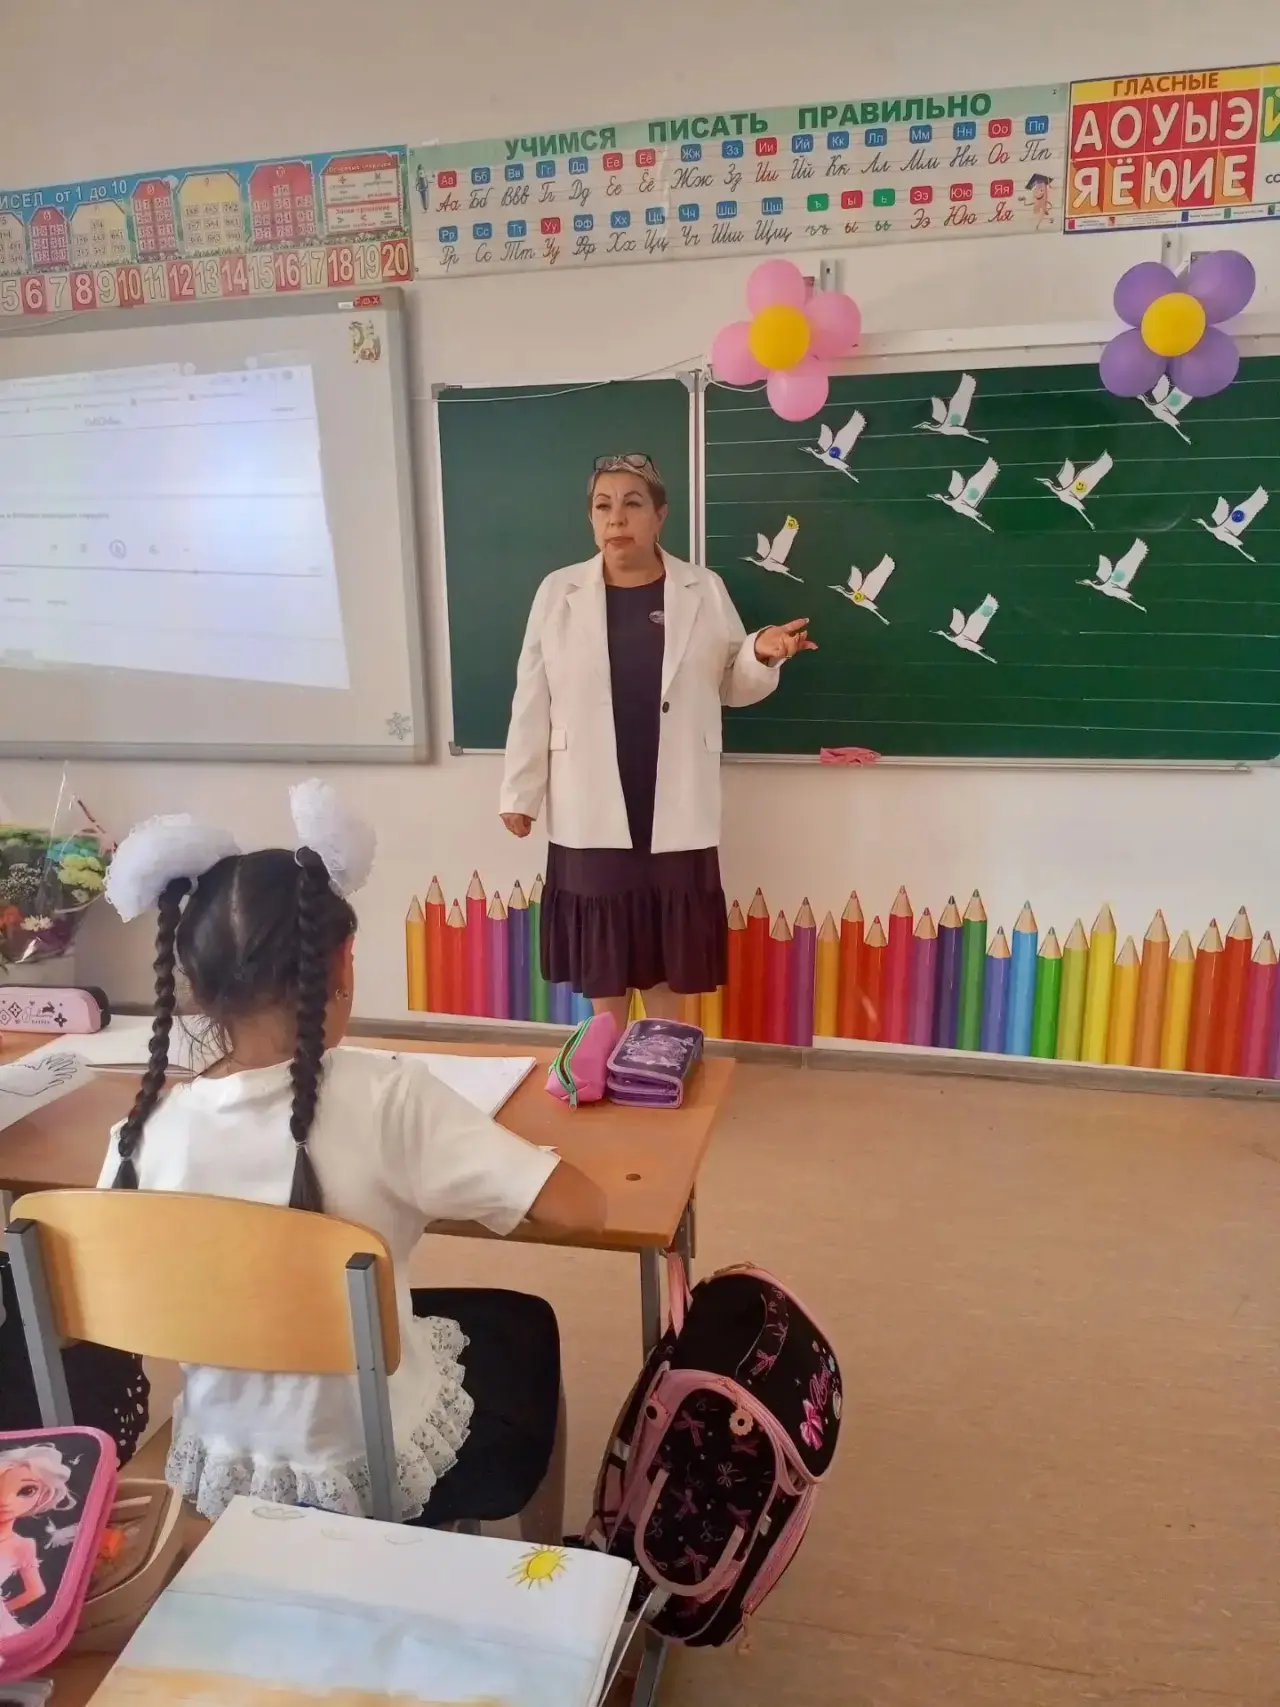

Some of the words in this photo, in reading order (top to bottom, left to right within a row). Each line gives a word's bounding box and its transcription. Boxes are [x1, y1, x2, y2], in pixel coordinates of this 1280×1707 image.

[1113, 72, 1219, 97] ГЛАСНЫЕ
[505, 127, 616, 160] УЧИМСЯ
[648, 113, 768, 143] ПИСАТЬ
[798, 93, 992, 129] ПРАВИЛЬНО
[55, 191, 70, 203] от
[76, 186, 82, 200] 1
[90, 185, 107, 202] до
[111, 180, 127, 194] 10
[2, 280, 20, 311] 5
[25, 279, 43, 308] 6
[49, 276, 67, 308] 7
[76, 273, 93, 304] 8
[97, 270, 116, 303] 9
[118, 268, 141, 301] 10
[144, 265, 165, 299] 11
[169, 264, 194, 296] 12
[195, 260, 219, 294] 13
[221, 258, 247, 292] 14
[249, 253, 275, 289] 15
[275, 253, 300, 287] 16
[300, 250, 326, 285] 17
[328, 248, 354, 282] 18
[354, 245, 380, 280] 19
[382, 242, 409, 277] 20
